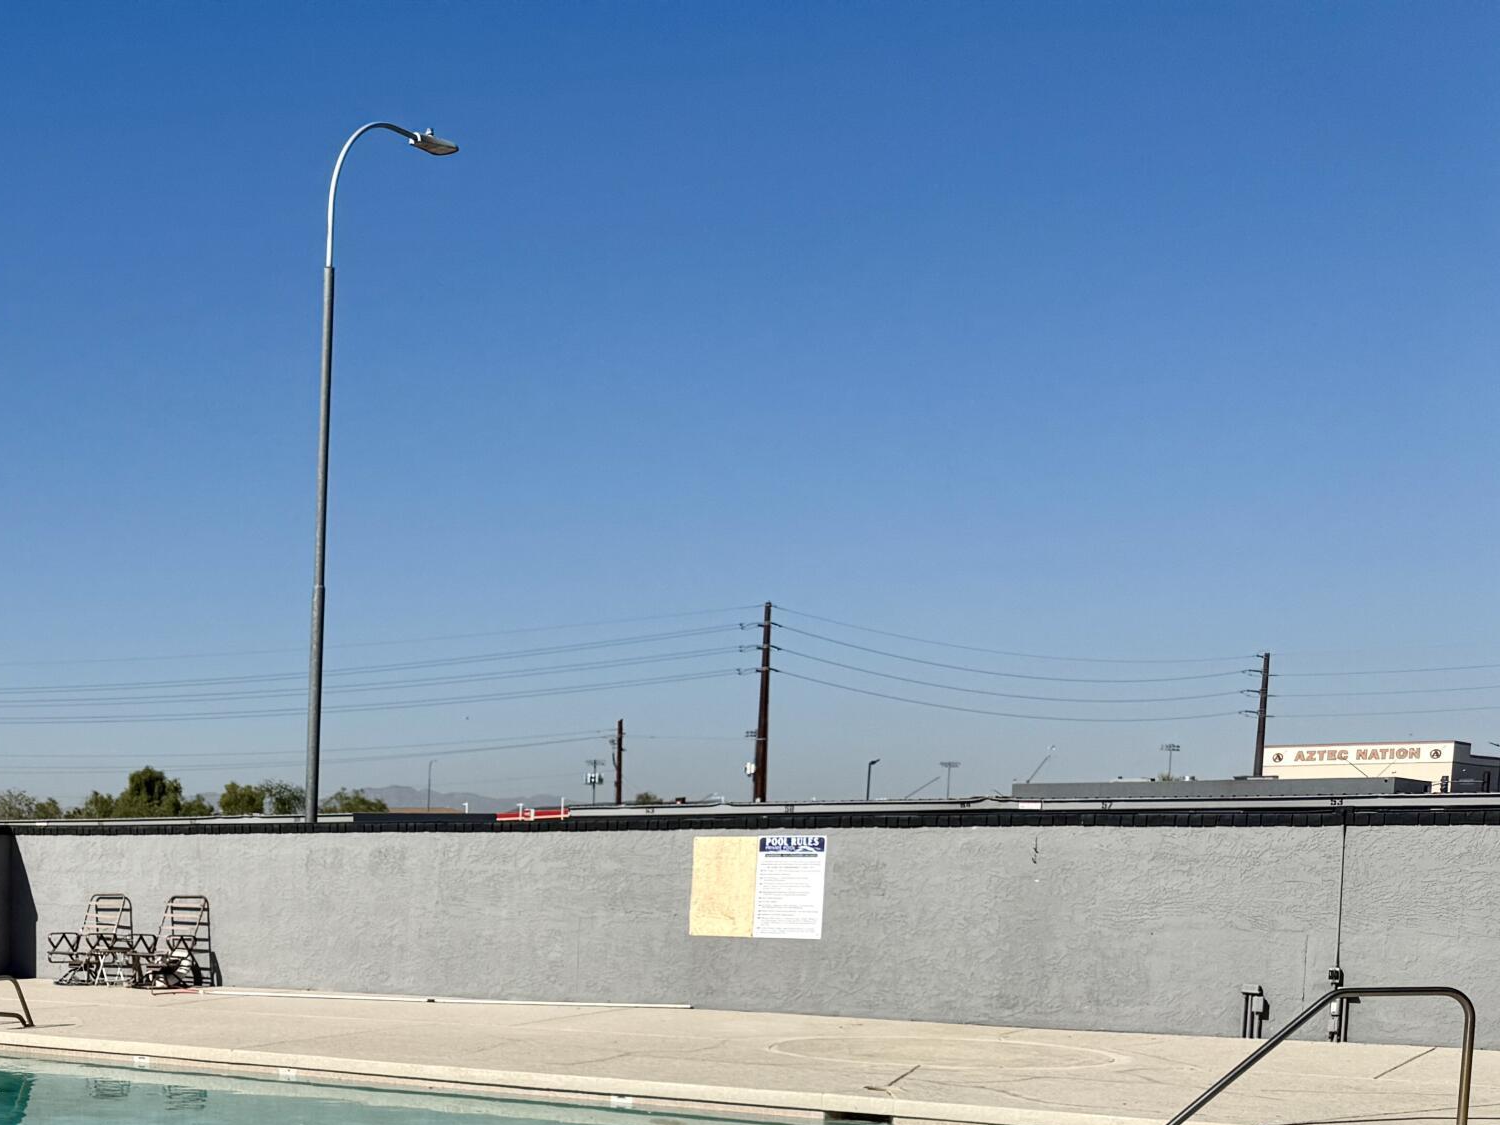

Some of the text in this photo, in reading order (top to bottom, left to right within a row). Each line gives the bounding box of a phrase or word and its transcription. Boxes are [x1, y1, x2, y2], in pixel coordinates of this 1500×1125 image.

[1294, 748, 1421, 762] AZTEC NATION
[765, 837, 819, 846] POOL RULES
